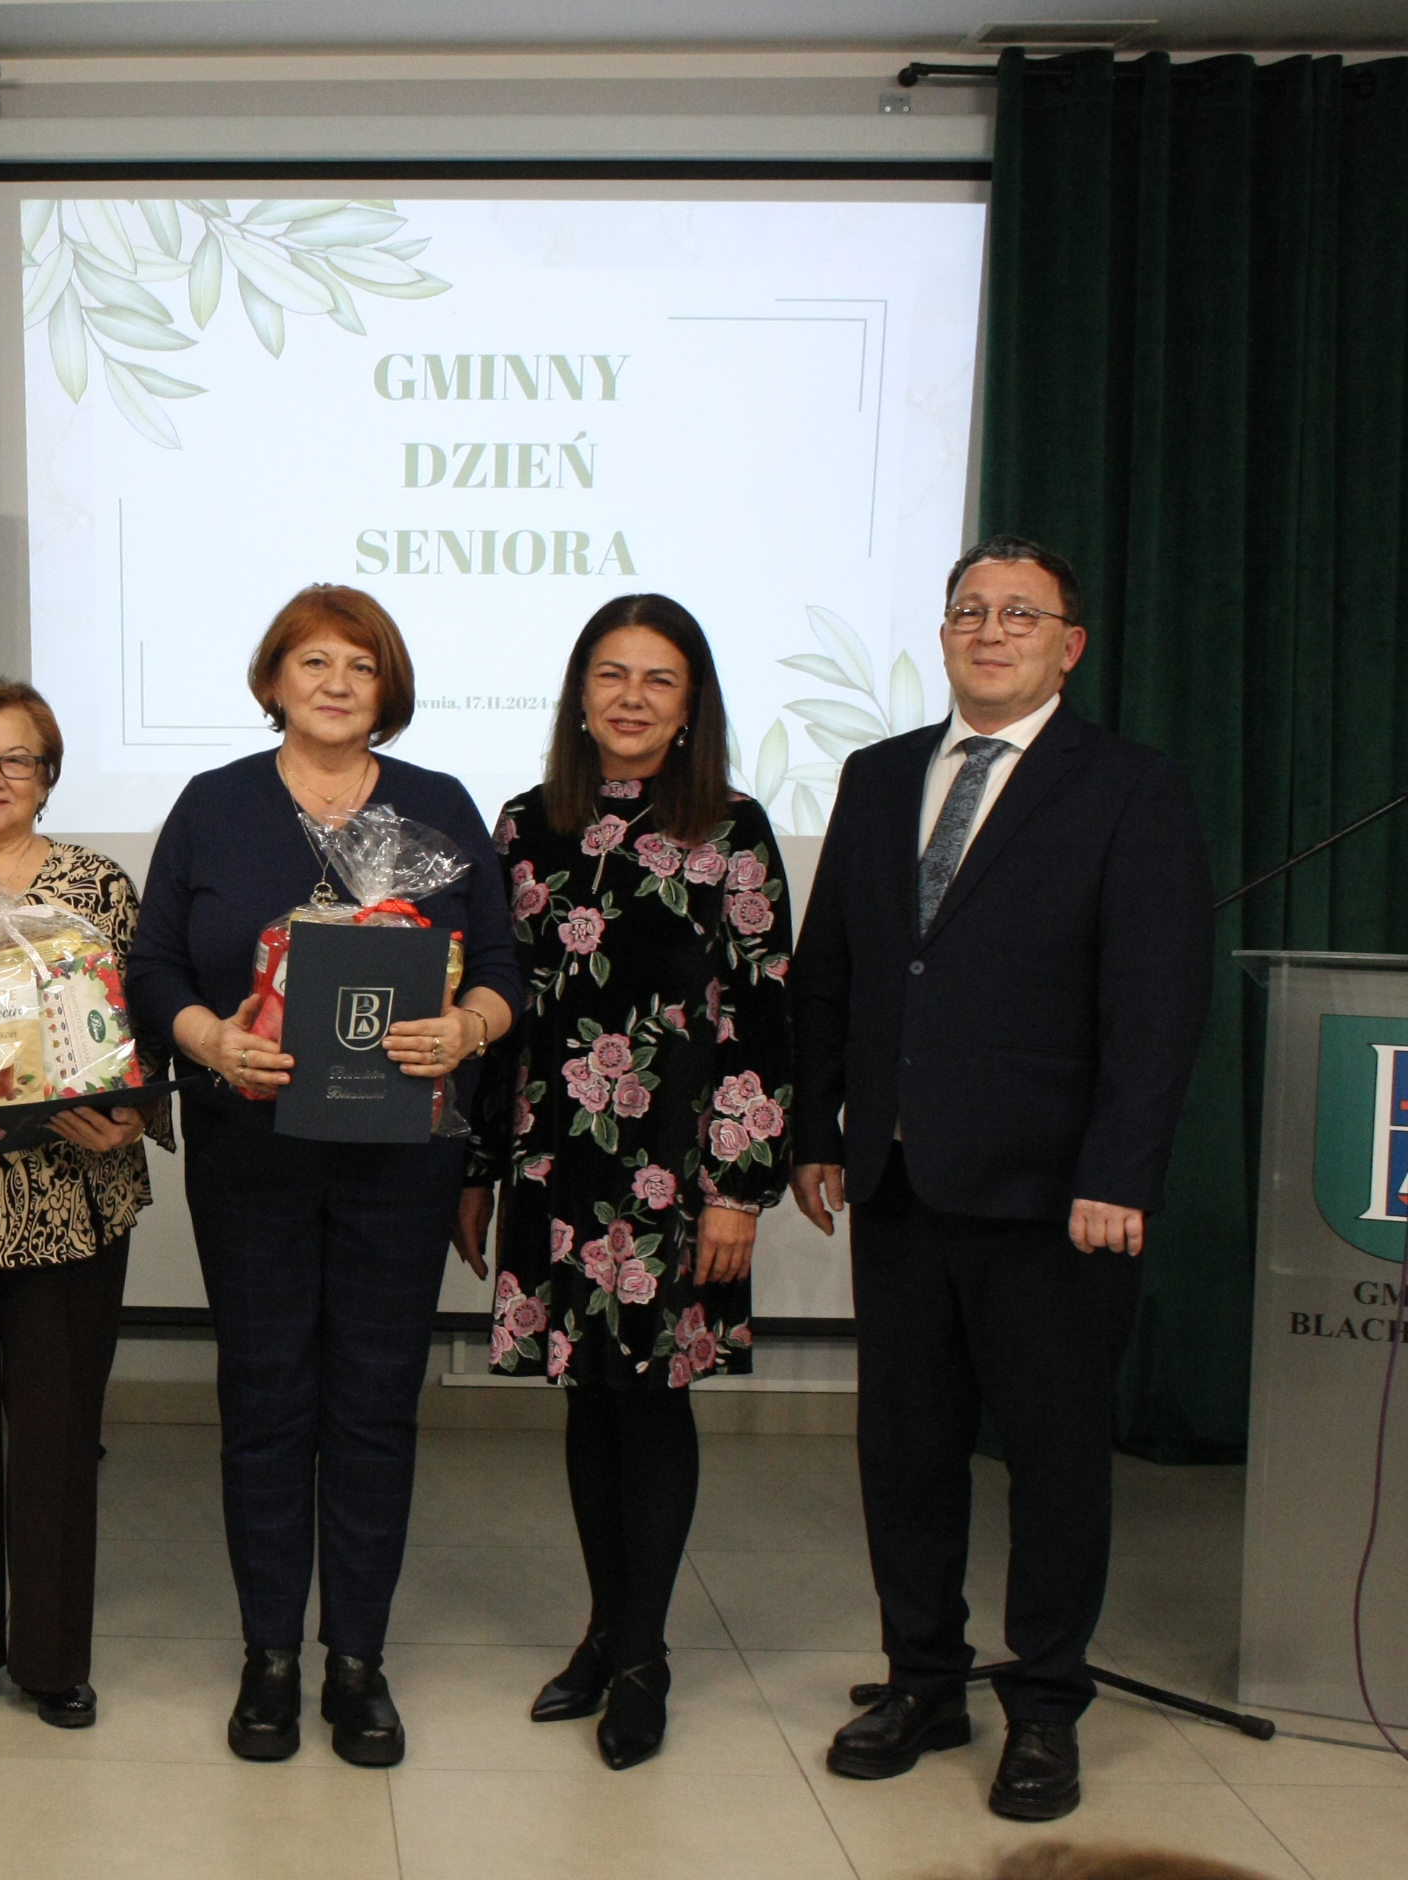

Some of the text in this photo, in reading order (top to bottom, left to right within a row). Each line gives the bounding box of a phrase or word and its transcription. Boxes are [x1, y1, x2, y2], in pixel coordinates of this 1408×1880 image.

[373, 353, 632, 401] GMINNY
[400, 430, 598, 489] DZIEŃ
[355, 528, 640, 576] SENIORA
[465, 696, 548, 711] 17.11.2024
[1289, 1311, 1408, 1343] BLACH
